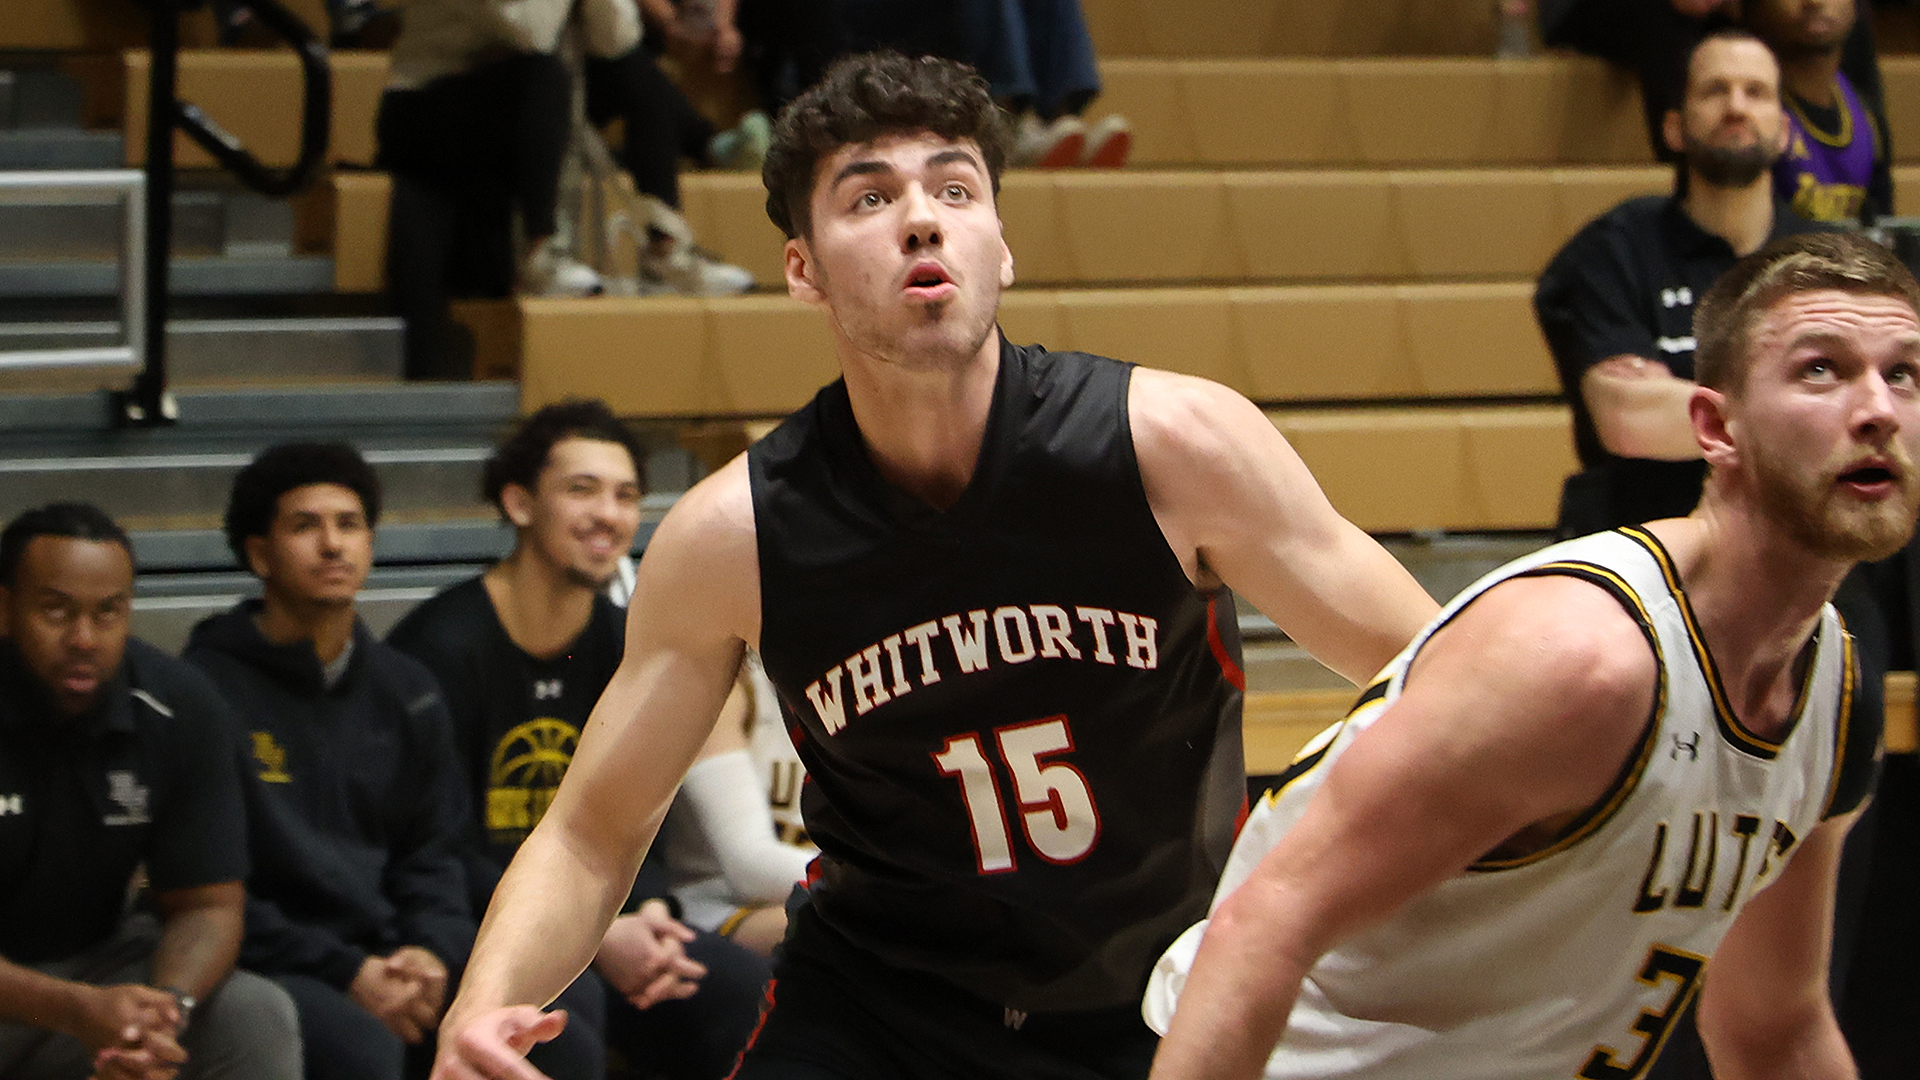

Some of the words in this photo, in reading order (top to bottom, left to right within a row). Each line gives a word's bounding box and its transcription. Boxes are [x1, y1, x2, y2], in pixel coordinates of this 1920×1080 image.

[806, 604, 1158, 736] WHITWORTH
[931, 715, 1101, 875] 15
[1004, 1007, 1028, 1030] W
